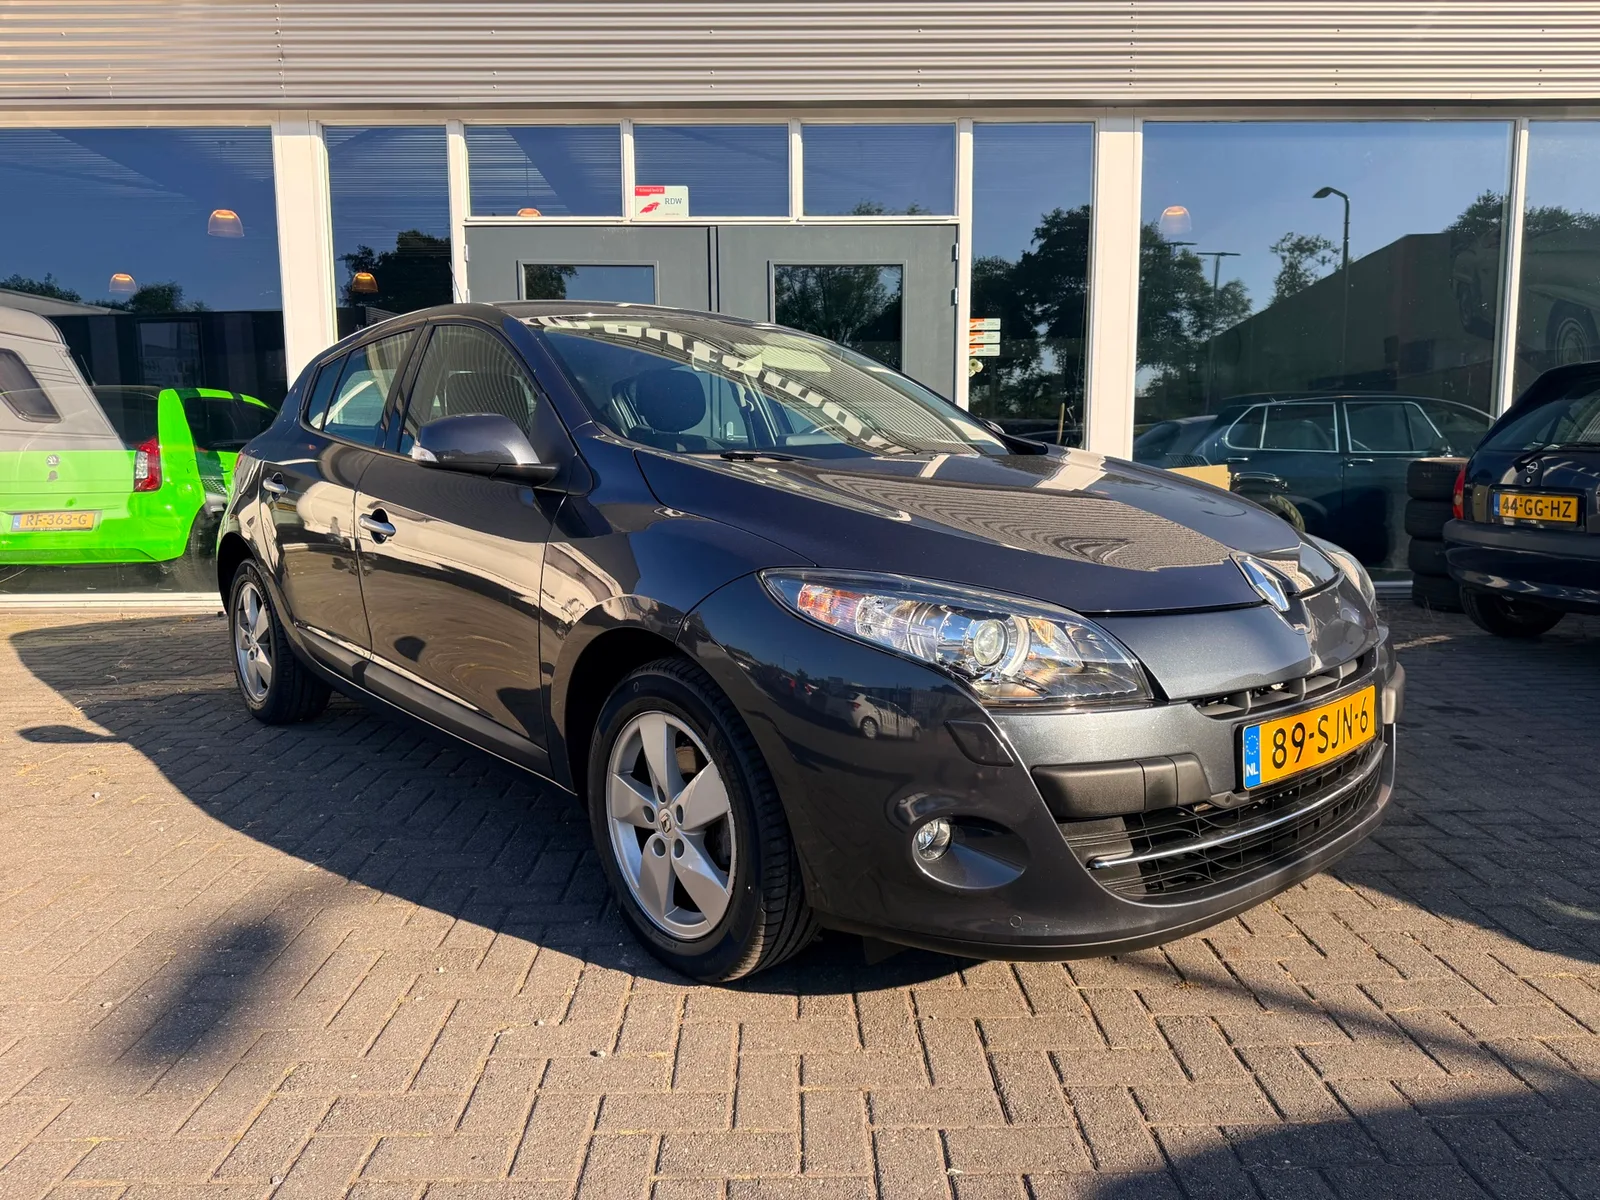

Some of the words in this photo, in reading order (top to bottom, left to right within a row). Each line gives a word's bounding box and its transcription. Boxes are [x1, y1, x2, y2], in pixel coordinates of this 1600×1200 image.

[664, 197, 682, 205] RDW
[1502, 496, 1572, 518] 44-GG-HZ
[25, 513, 87, 526] RF-363-G
[1272, 696, 1368, 769] 89-SJN-6
[1246, 762, 1259, 777] NL
